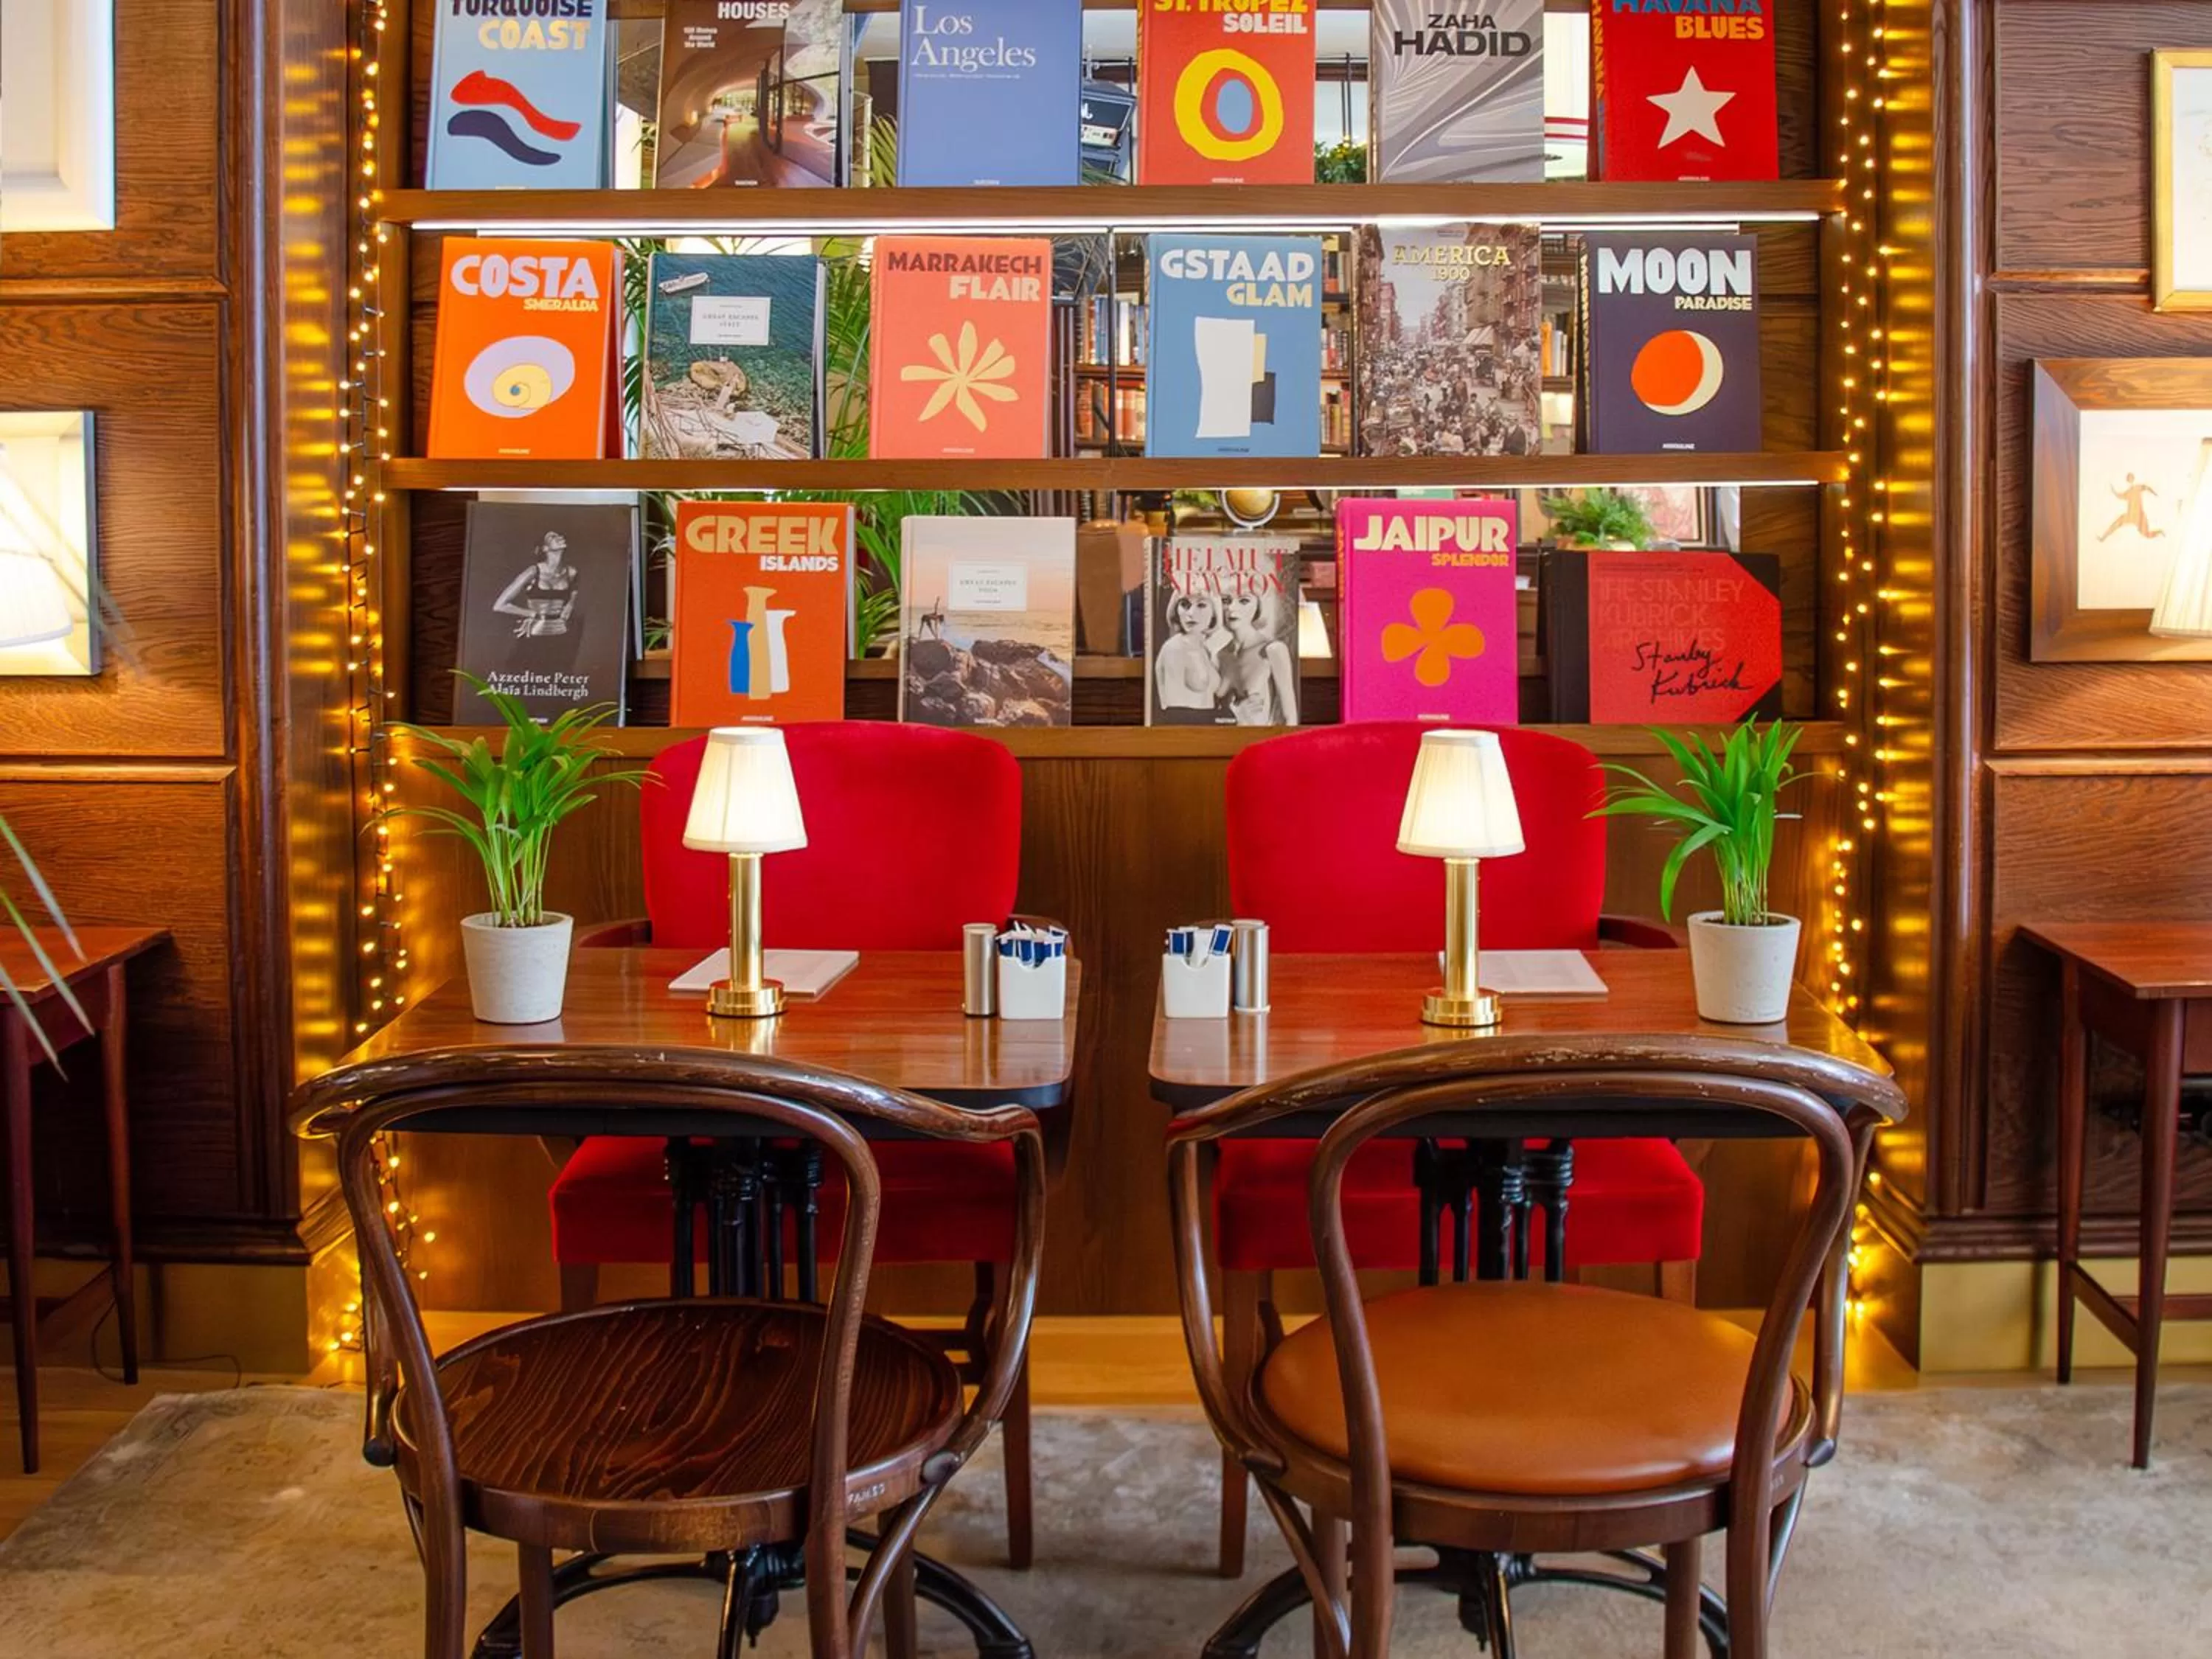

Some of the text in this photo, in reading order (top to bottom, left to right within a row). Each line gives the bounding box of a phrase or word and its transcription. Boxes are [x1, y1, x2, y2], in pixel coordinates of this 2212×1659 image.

[451, 0, 593, 17] TURQUOISE
[717, 2, 790, 19] HOUSES
[913, 5, 973, 35] Los
[1222, 13, 1308, 34] SOLEIL
[1427, 14, 1497, 29] ZAHA
[1674, 15, 1765, 40] BLUES
[479, 19, 591, 50] COAST
[1394, 30, 1532, 57] HADID
[910, 37, 1037, 72] Angeles
[888, 251, 1042, 274] MARRAKECH
[1160, 248, 1315, 282] GSTAAD
[1391, 246, 1512, 266] AMERICA
[450, 254, 600, 298] COSTA
[1430, 266, 1471, 282] 1900
[1597, 247, 1753, 296] MOON
[949, 275, 1041, 302] FLAIR
[1226, 283, 1313, 307] GLAM
[523, 298, 599, 313] SMERALDA
[1674, 296, 1753, 310] PARADISE
[685, 515, 838, 554] GREEK
[1353, 515, 1510, 552] JAIPUR
[759, 554, 838, 572] ISLANDS
[1431, 553, 1509, 567] SPLENDOR
[1641, 578, 1745, 602] STANLEY
[1599, 602, 1711, 626] KUBRICK
[487, 670, 590, 684] Azzedine Peter
[524, 684, 590, 701] Lindbergh
